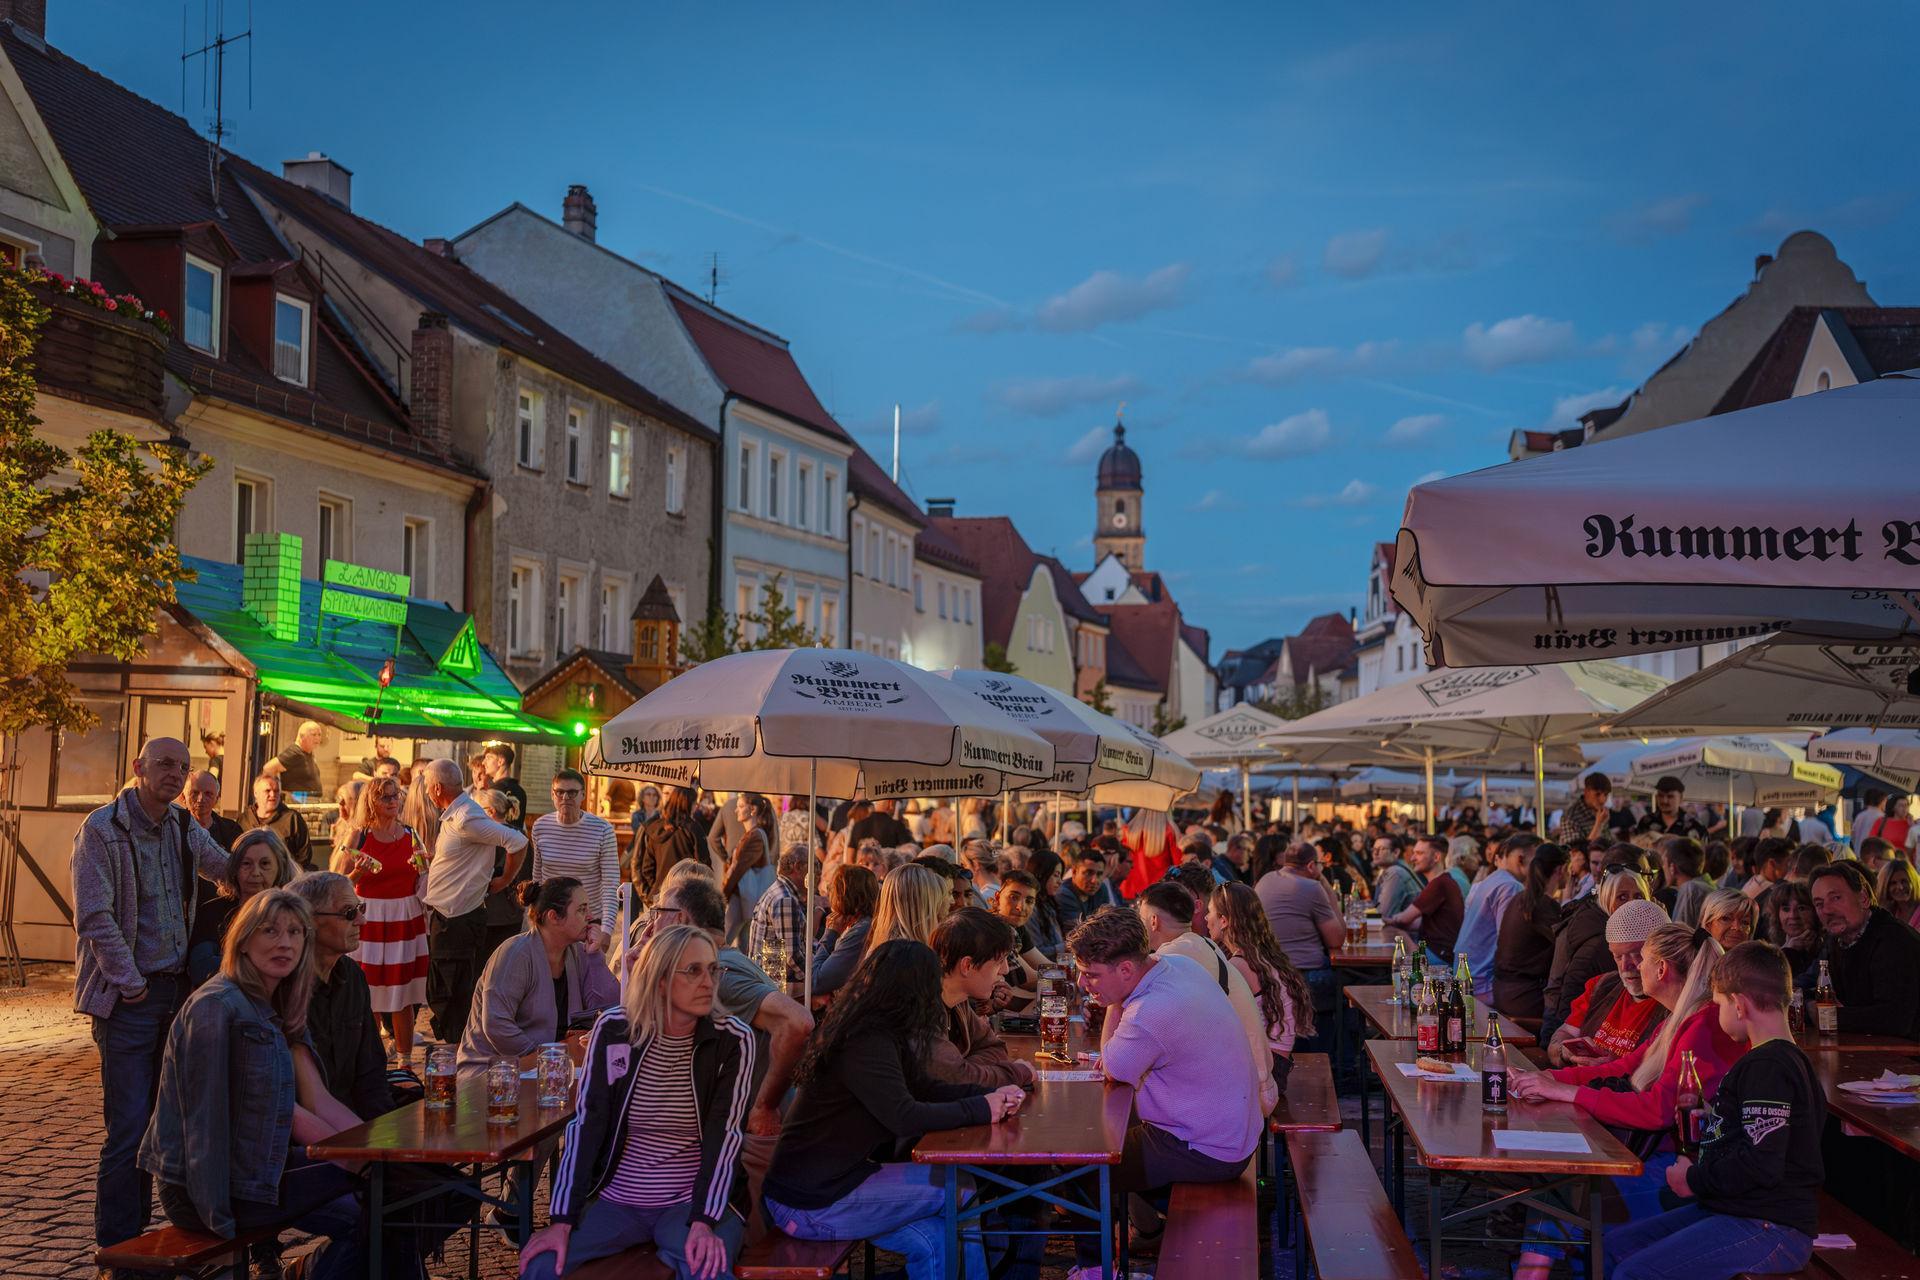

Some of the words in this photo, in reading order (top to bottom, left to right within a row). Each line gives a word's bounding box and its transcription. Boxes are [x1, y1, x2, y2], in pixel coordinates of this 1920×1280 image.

[1583, 513, 1863, 562] Kummert
[791, 673, 902, 692] Kummert
[816, 686, 881, 701] Bräu
[973, 692, 1048, 704] ummert
[823, 699, 882, 708] AMBERG
[621, 734, 701, 756] Kummert
[704, 732, 740, 751] Bräu
